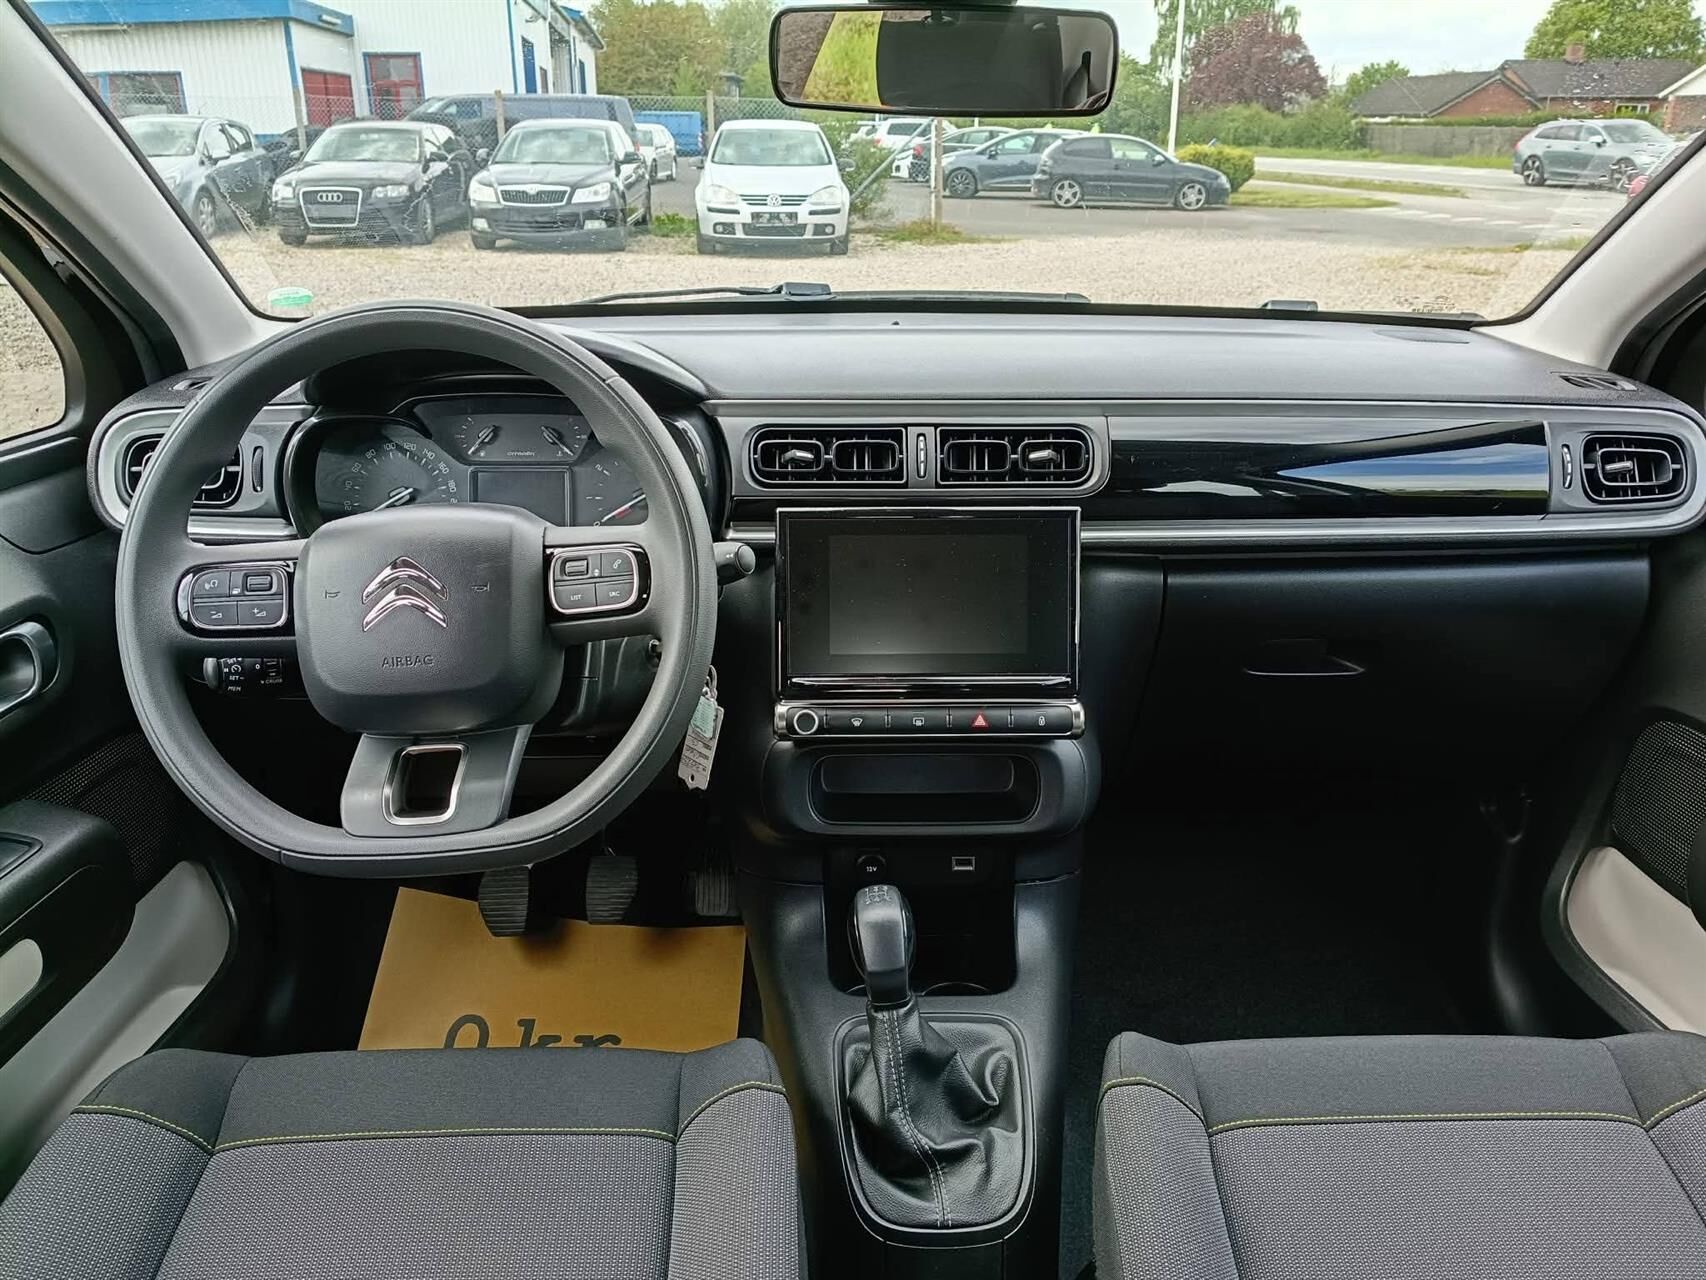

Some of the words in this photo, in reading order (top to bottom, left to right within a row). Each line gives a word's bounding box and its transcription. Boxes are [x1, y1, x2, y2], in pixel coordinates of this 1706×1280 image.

[384, 442, 396, 451] 100
[403, 442, 417, 451] 120
[365, 449, 376, 459] 80
[422, 448, 435, 460] 140
[352, 463, 361, 473] 60
[438, 461, 450, 474] 160
[595, 463, 603, 471] 2
[344, 480, 353, 491] 40
[447, 479, 457, 493] 180
[344, 500, 352, 511] 20
[382, 654, 434, 668] AIRBAG
